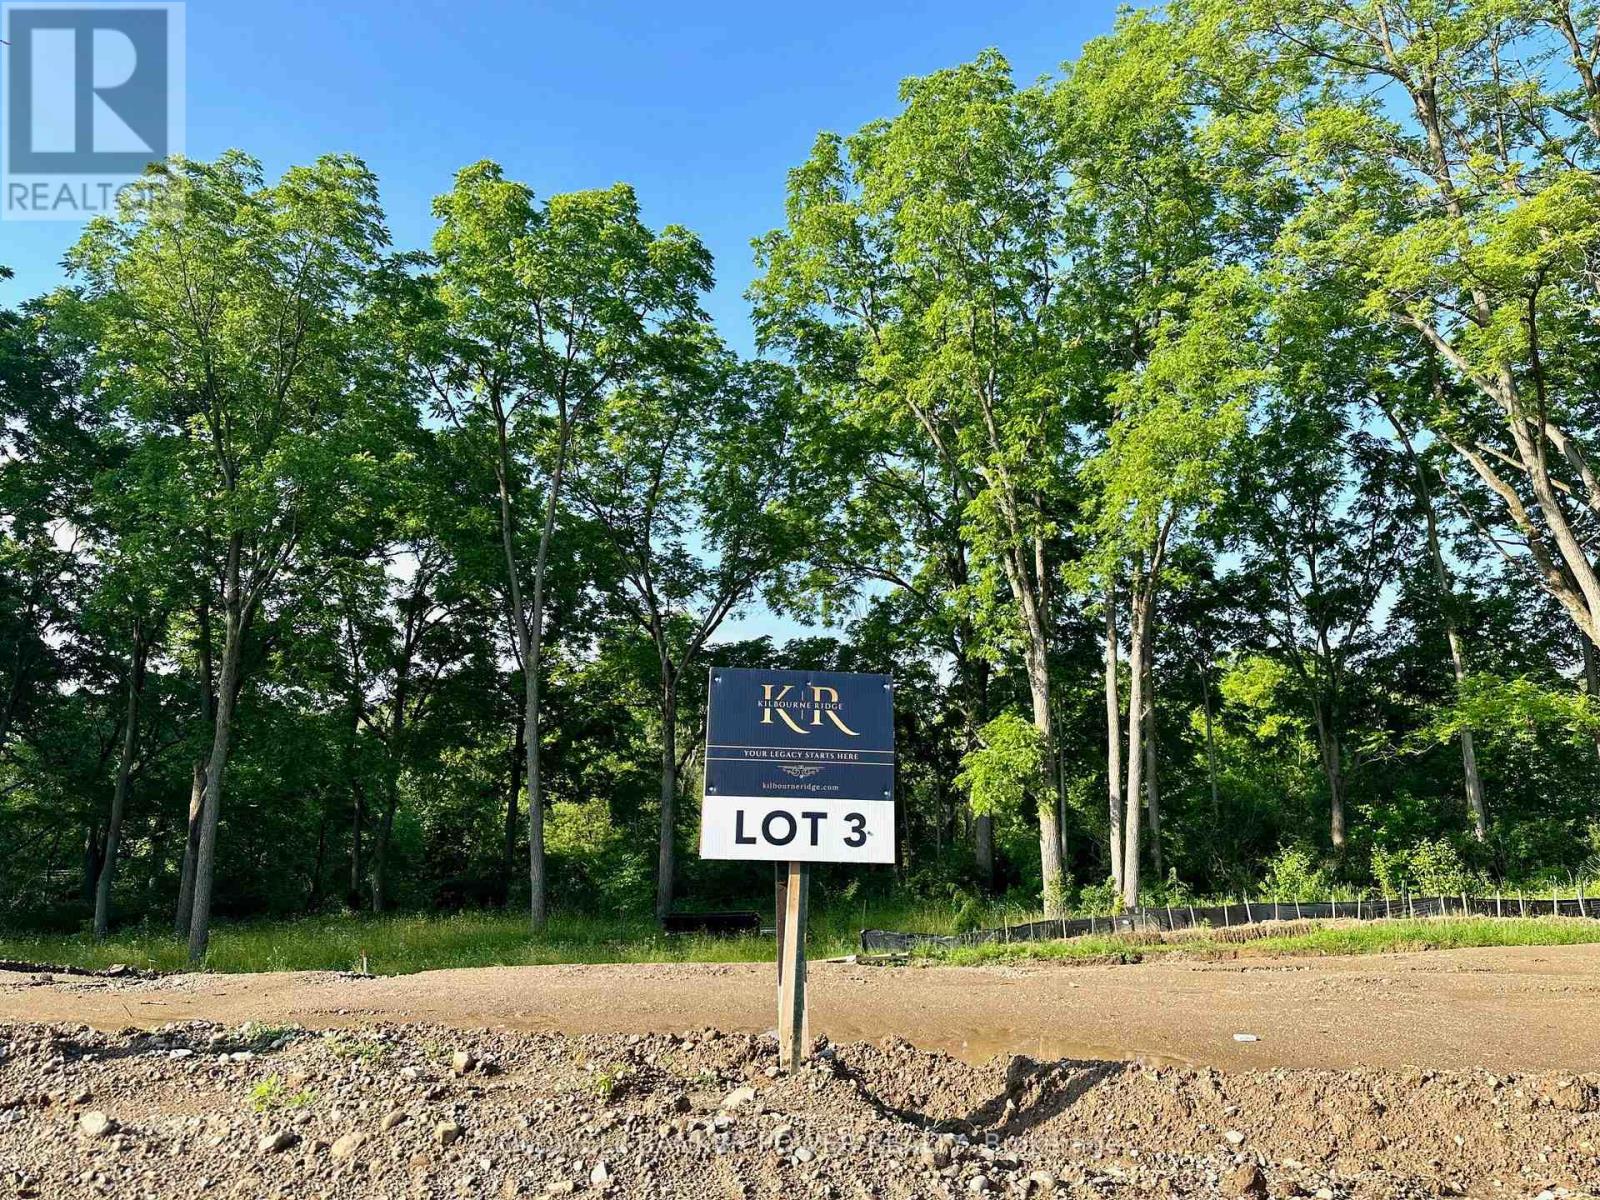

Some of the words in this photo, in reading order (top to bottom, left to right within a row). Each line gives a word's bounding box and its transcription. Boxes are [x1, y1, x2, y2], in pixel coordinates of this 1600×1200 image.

[757, 700, 812, 709] KILBOURNE
[814, 702, 843, 711] RIDGE
[743, 749, 767, 758] YOUR
[770, 750, 802, 759] LEGACY
[804, 751, 835, 760] STARTS
[762, 782, 839, 792] kilbourneridge.com
[735, 809, 828, 846] LOT
[843, 812, 867, 848] 3
